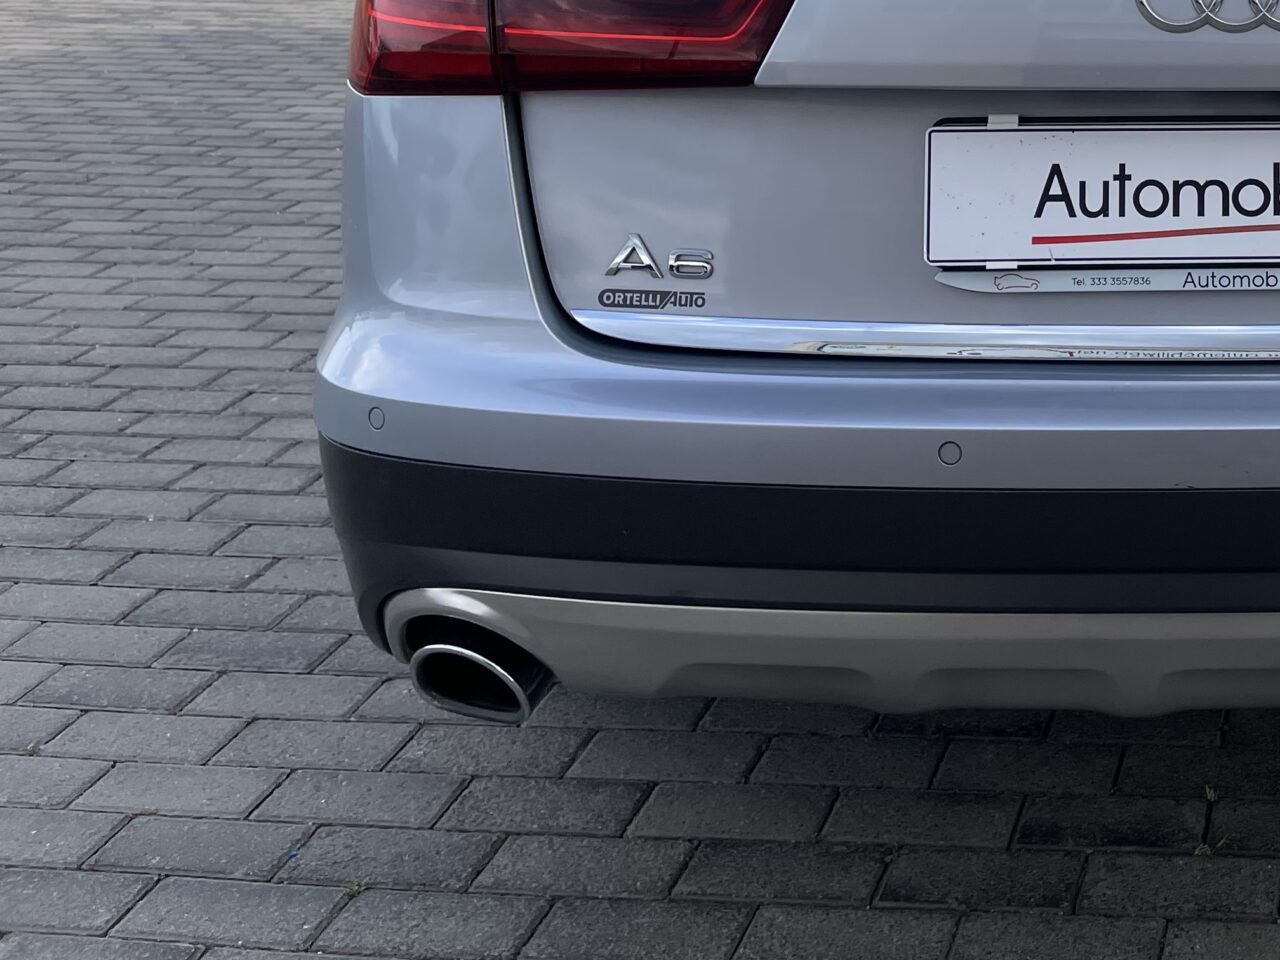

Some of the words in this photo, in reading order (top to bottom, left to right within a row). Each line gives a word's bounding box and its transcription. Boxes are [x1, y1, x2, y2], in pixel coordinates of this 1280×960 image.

[604, 232, 714, 280] A6
[1071, 277, 1087, 287] Tel.
[1090, 277, 1108, 286] 333
[1110, 276, 1151, 286] 3557836
[602, 291, 661, 307] ORTELLI
